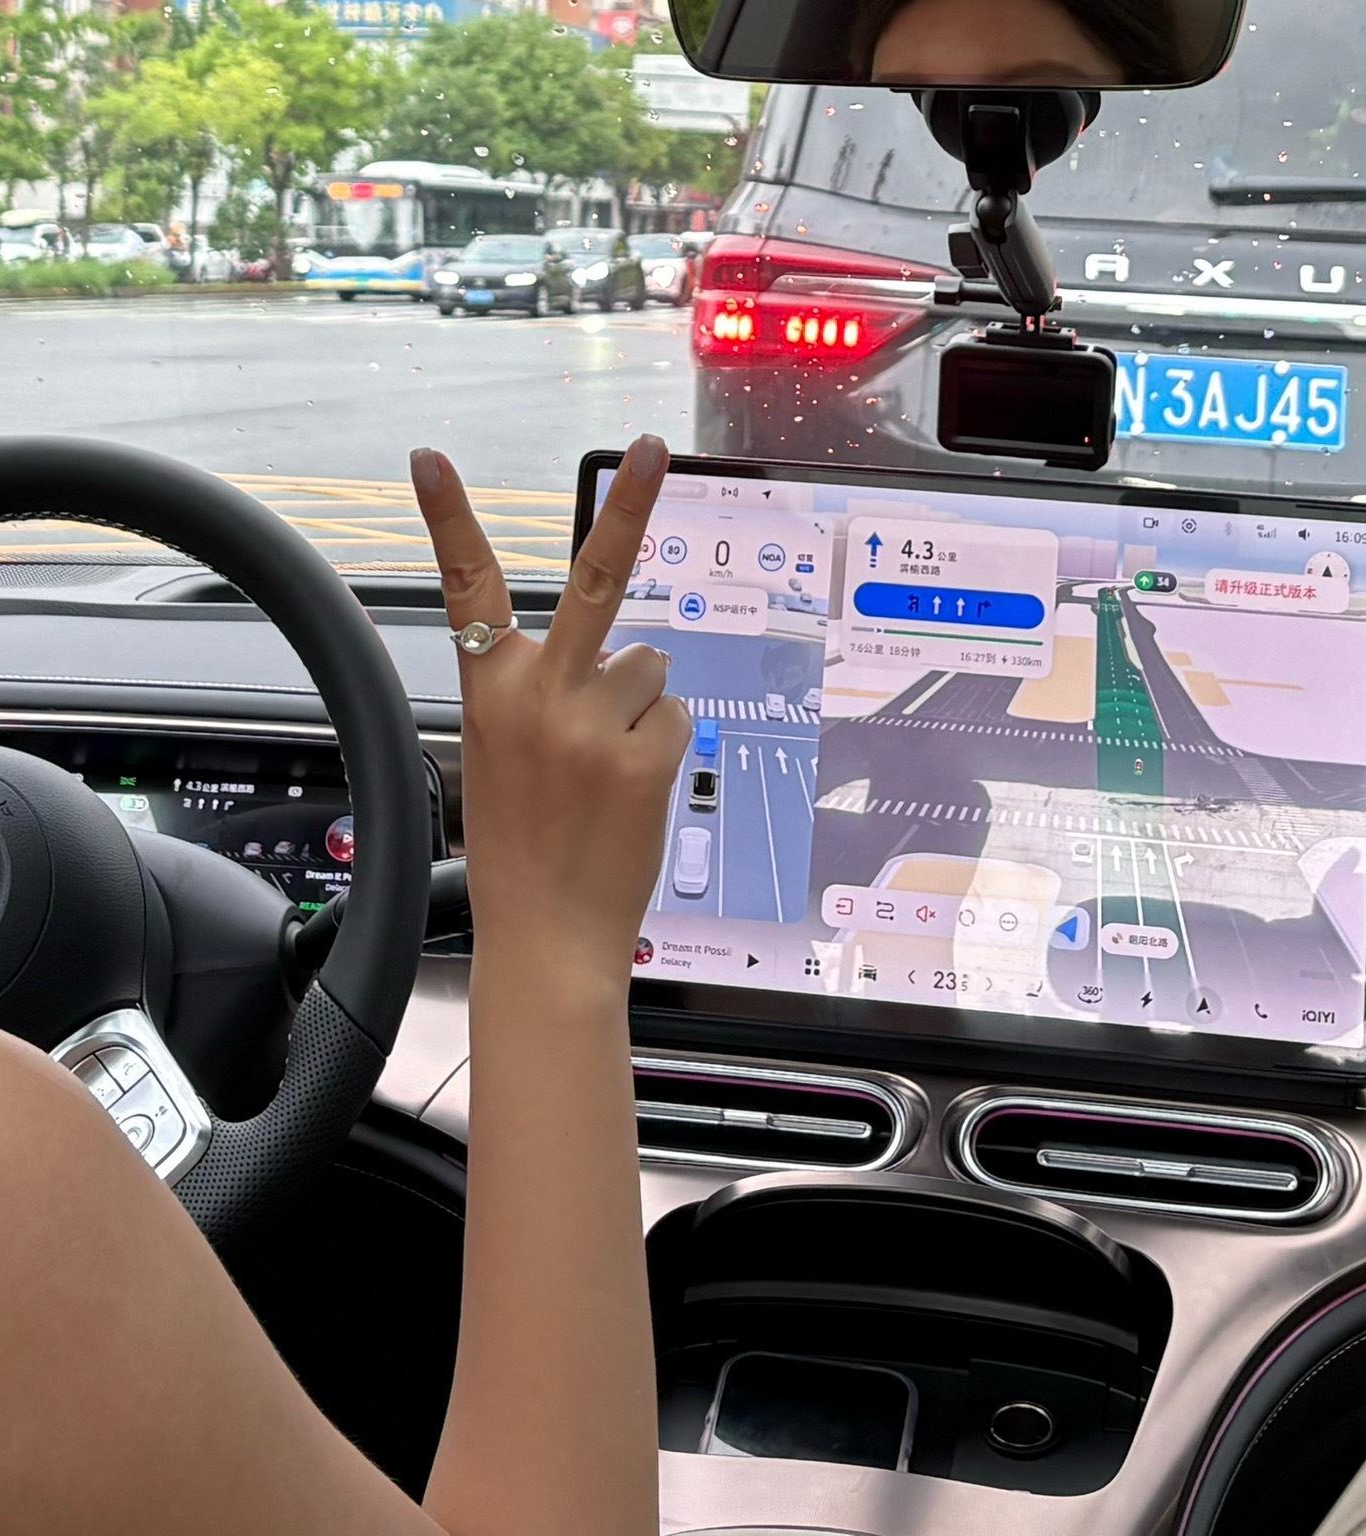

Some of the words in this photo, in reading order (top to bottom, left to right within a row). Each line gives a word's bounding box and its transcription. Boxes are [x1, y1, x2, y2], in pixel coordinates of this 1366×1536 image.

[667, 544, 681, 556] 80
[715, 540, 730, 567] 0
[761, 553, 783, 563] NOA
[708, 568, 734, 579] km/h
[1214, 579, 1317, 600] 请升级正式版本
[889, 646, 921, 658] 18分钟
[1127, 934, 1169, 948] 朝阳北路
[661, 941, 694, 954] Dream
